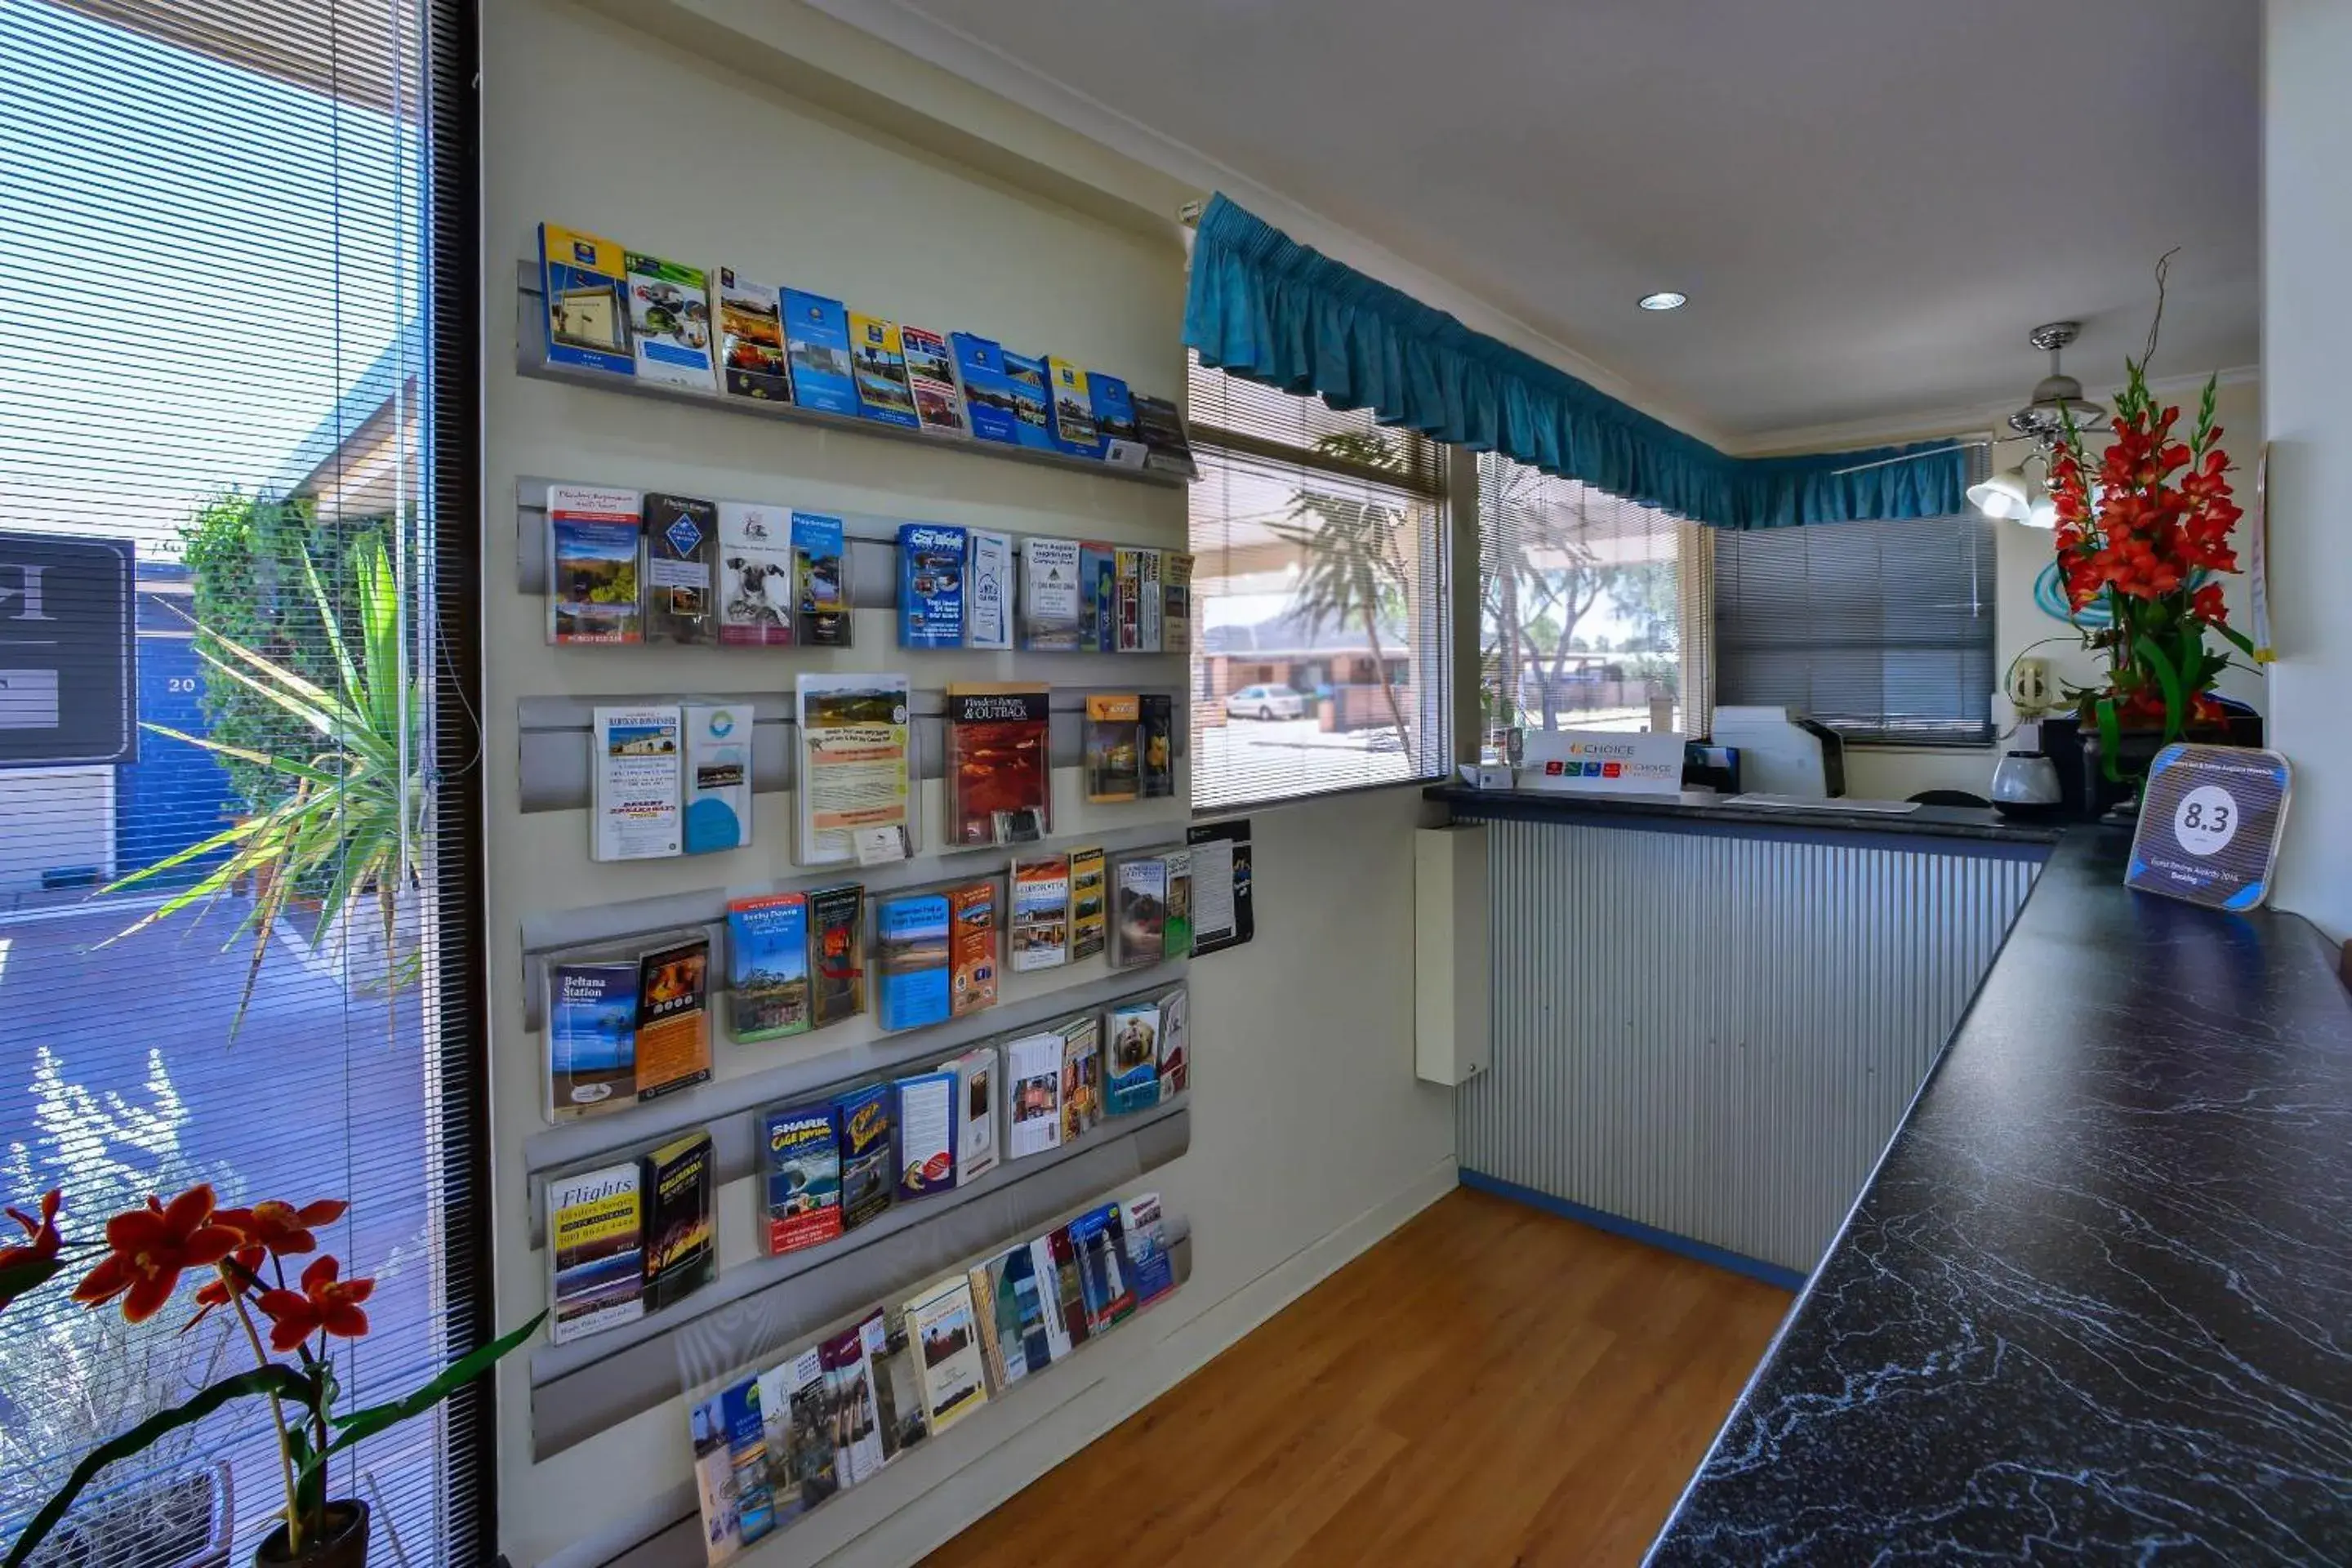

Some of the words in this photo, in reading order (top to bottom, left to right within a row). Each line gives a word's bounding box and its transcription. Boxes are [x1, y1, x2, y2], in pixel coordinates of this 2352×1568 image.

[168, 678, 195, 693] 20
[975, 706, 1027, 719] OUTBACK
[1584, 744, 1637, 755] CHOICE
[2184, 802, 2230, 833] 8.3
[564, 976, 606, 987] Beltana
[563, 987, 603, 998] Station
[772, 1117, 829, 1136] SHARK
[771, 1131, 798, 1152] CAGE
[799, 1126, 832, 1142] DIVING
[562, 1180, 635, 1209] Flights
